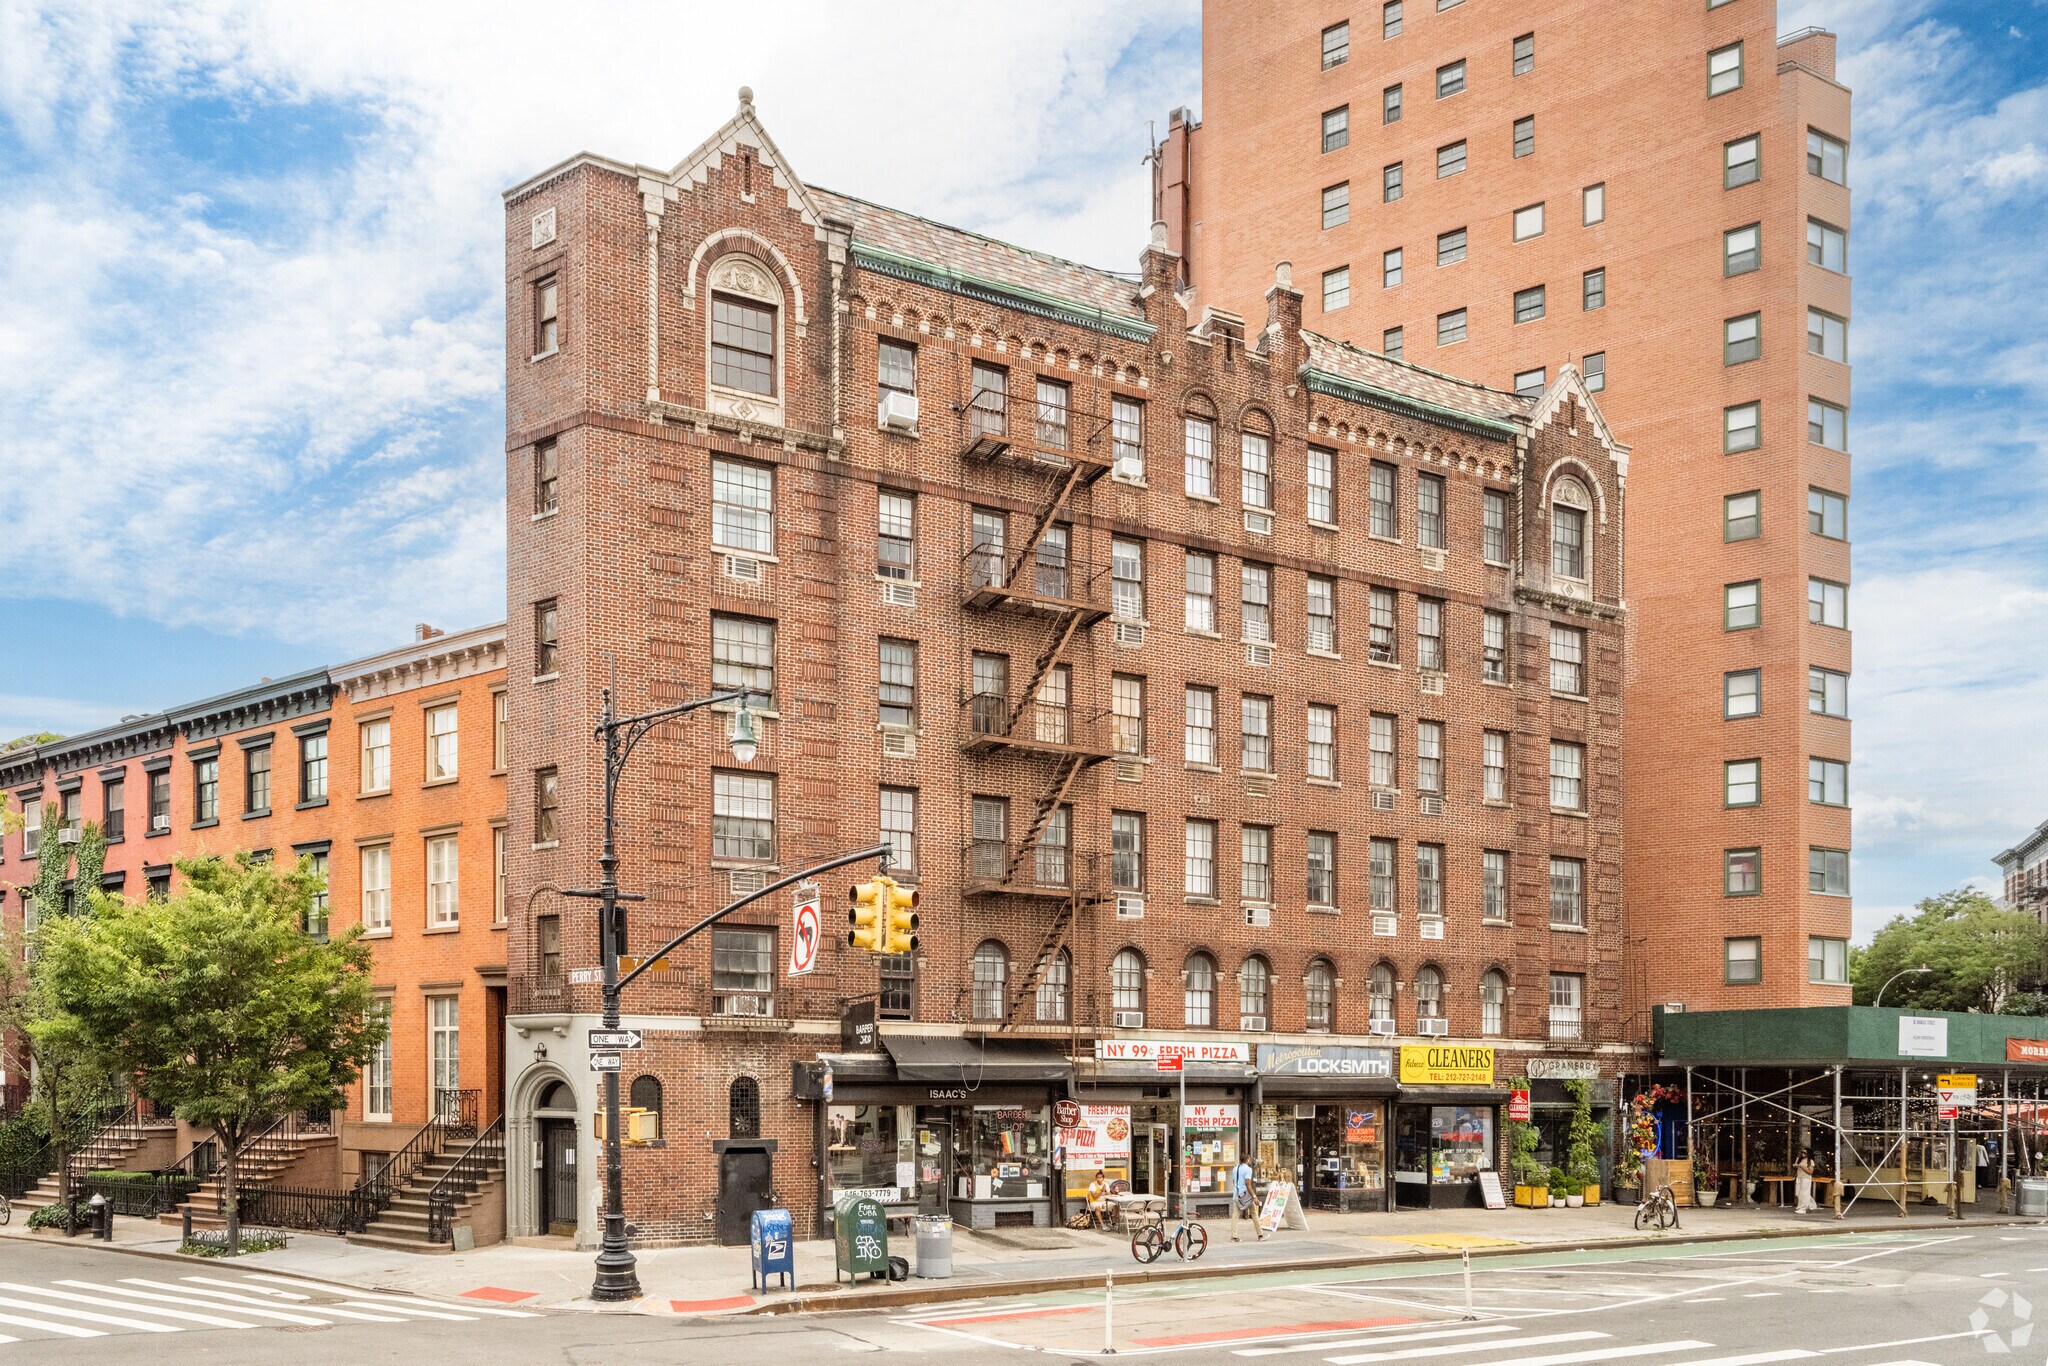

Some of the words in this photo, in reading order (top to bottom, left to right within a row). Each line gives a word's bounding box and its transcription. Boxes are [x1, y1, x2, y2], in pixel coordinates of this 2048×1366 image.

[571, 970, 592, 983] PERRY
[594, 969, 602, 981] ST
[855, 1023, 874, 1035] BARBER
[592, 1035, 610, 1043] ONE
[617, 1035, 635, 1043] WAY
[1107, 1044, 1126, 1057] NY
[1159, 1045, 1195, 1059] FRESH
[1201, 1047, 1239, 1060] PIZZA
[593, 1057, 603, 1066] ONE
[607, 1057, 619, 1065] WAY
[1260, 1045, 1322, 1072] Metropolitan
[1427, 1048, 1491, 1069] CLEANERS
[1297, 1058, 1390, 1074] LOCKSMITH
[1548, 1061, 1597, 1071] GRAMERCY
[1429, 1072, 1444, 1081] TEL:
[1445, 1073, 1487, 1082] 212-727-2148
[929, 1089, 967, 1099] ISAAC'S
[1056, 1103, 1078, 1116] Barber
[1087, 1105, 1109, 1115] FRESH
[1110, 1105, 1129, 1115] PIZZA
[1194, 1106, 1207, 1116] NY
[996, 1110, 1028, 1120] BARBER
[1060, 1114, 1074, 1126] Shop
[1000, 1122, 1025, 1132] SHOP
[1212, 1117, 1238, 1127] PIZZA
[1076, 1129, 1096, 1148] PIZZA
[844, 1190, 891, 1198] 646-763-7779
